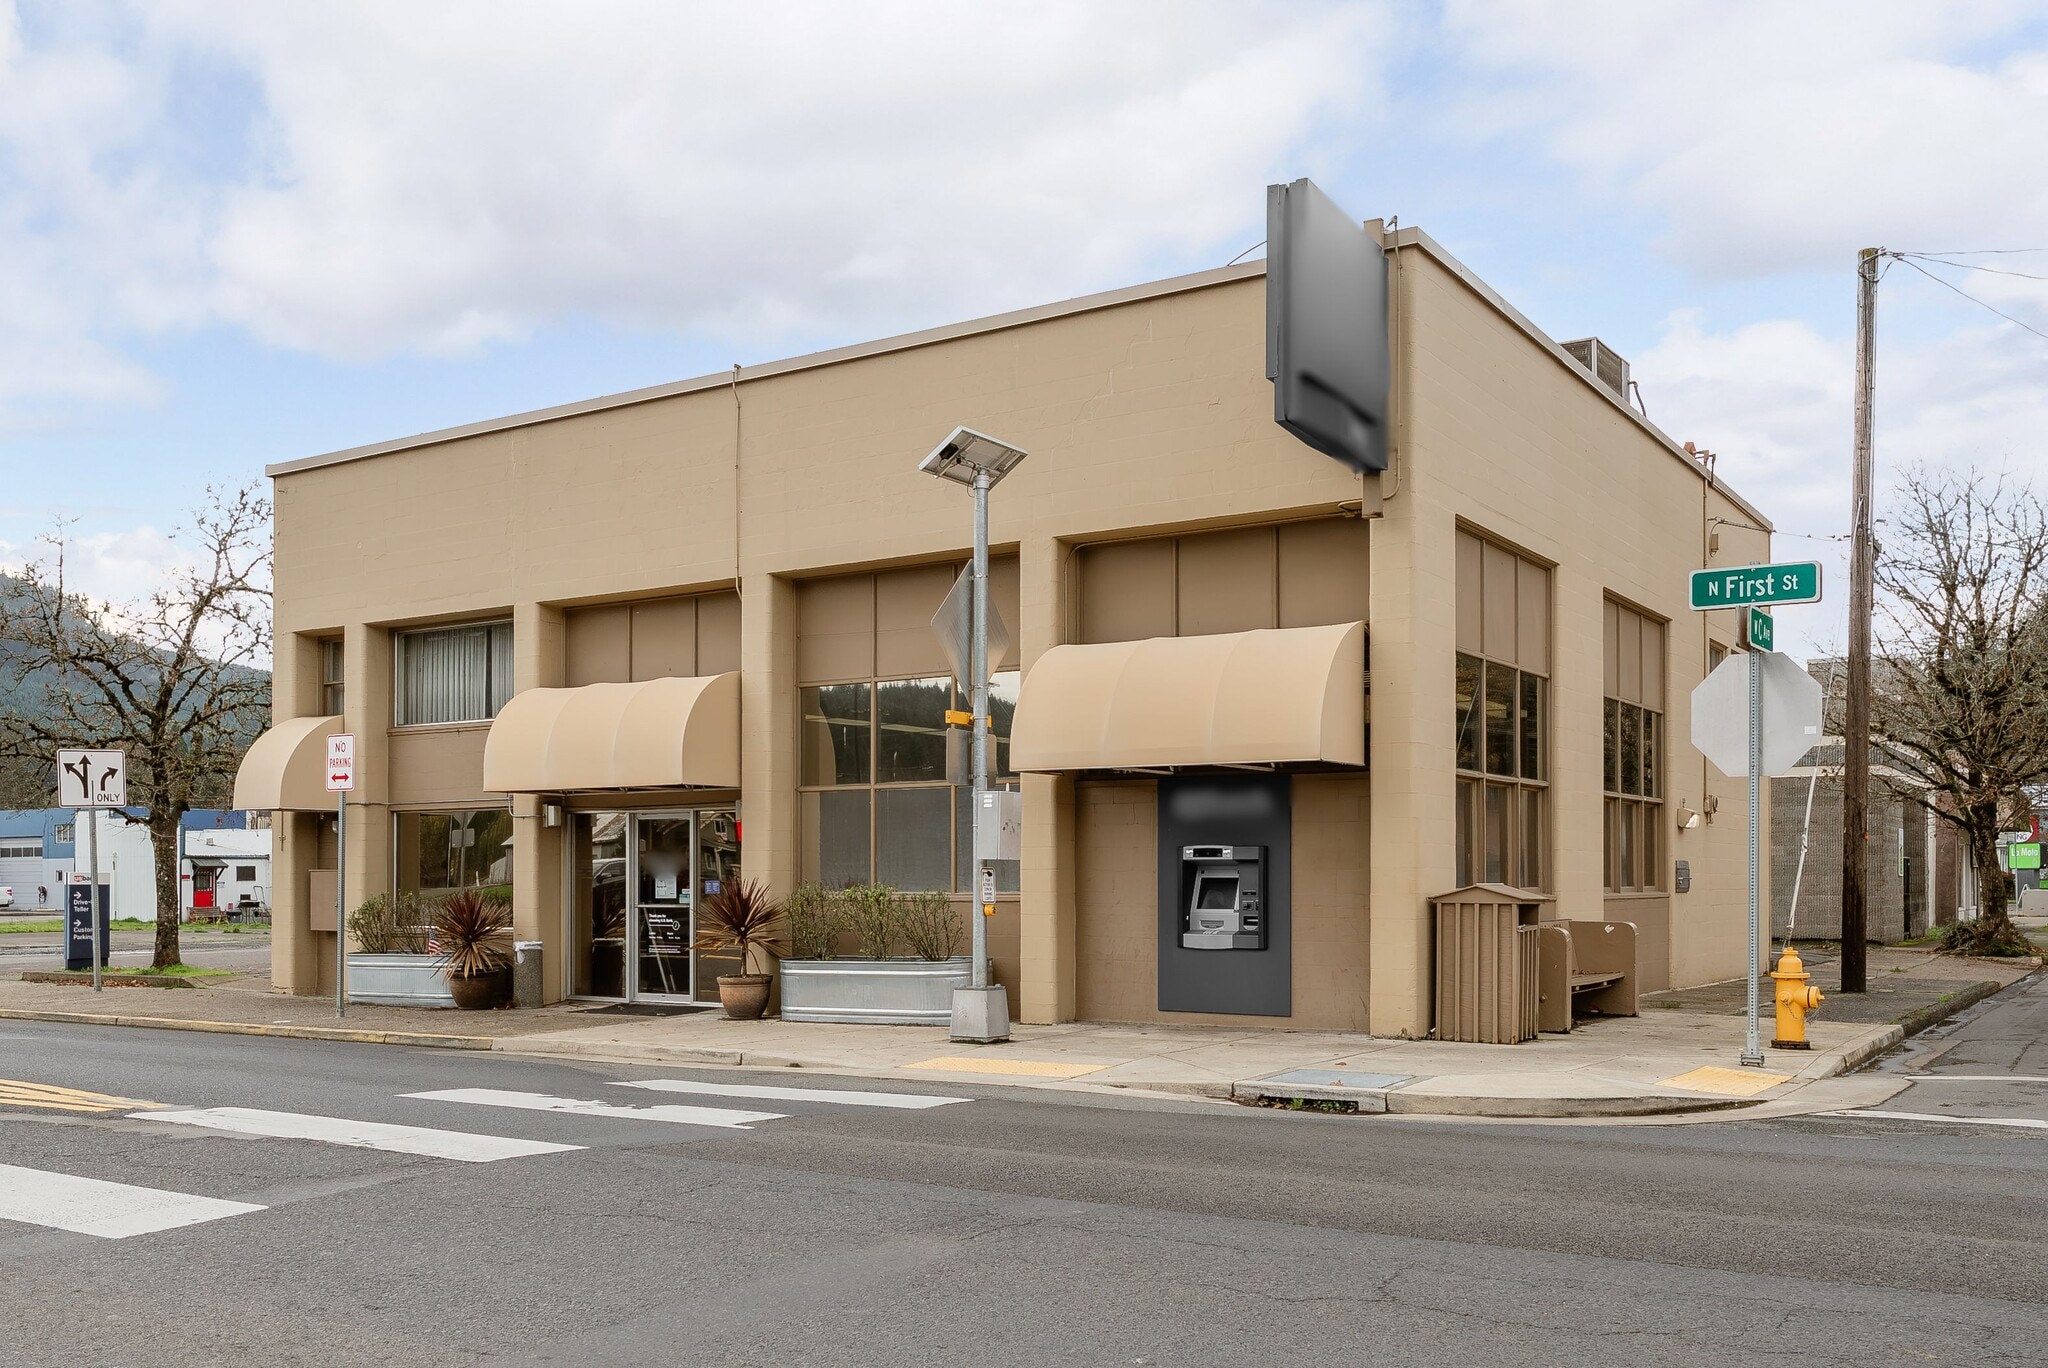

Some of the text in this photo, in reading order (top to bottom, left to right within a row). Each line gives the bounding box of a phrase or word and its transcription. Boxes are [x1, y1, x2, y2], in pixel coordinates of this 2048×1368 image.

[1708, 573, 1799, 599] N First St
[1758, 618, 1763, 641] C
[335, 742, 346, 752] NO
[329, 758, 351, 768] PARKING
[96, 793, 121, 802] ONLY
